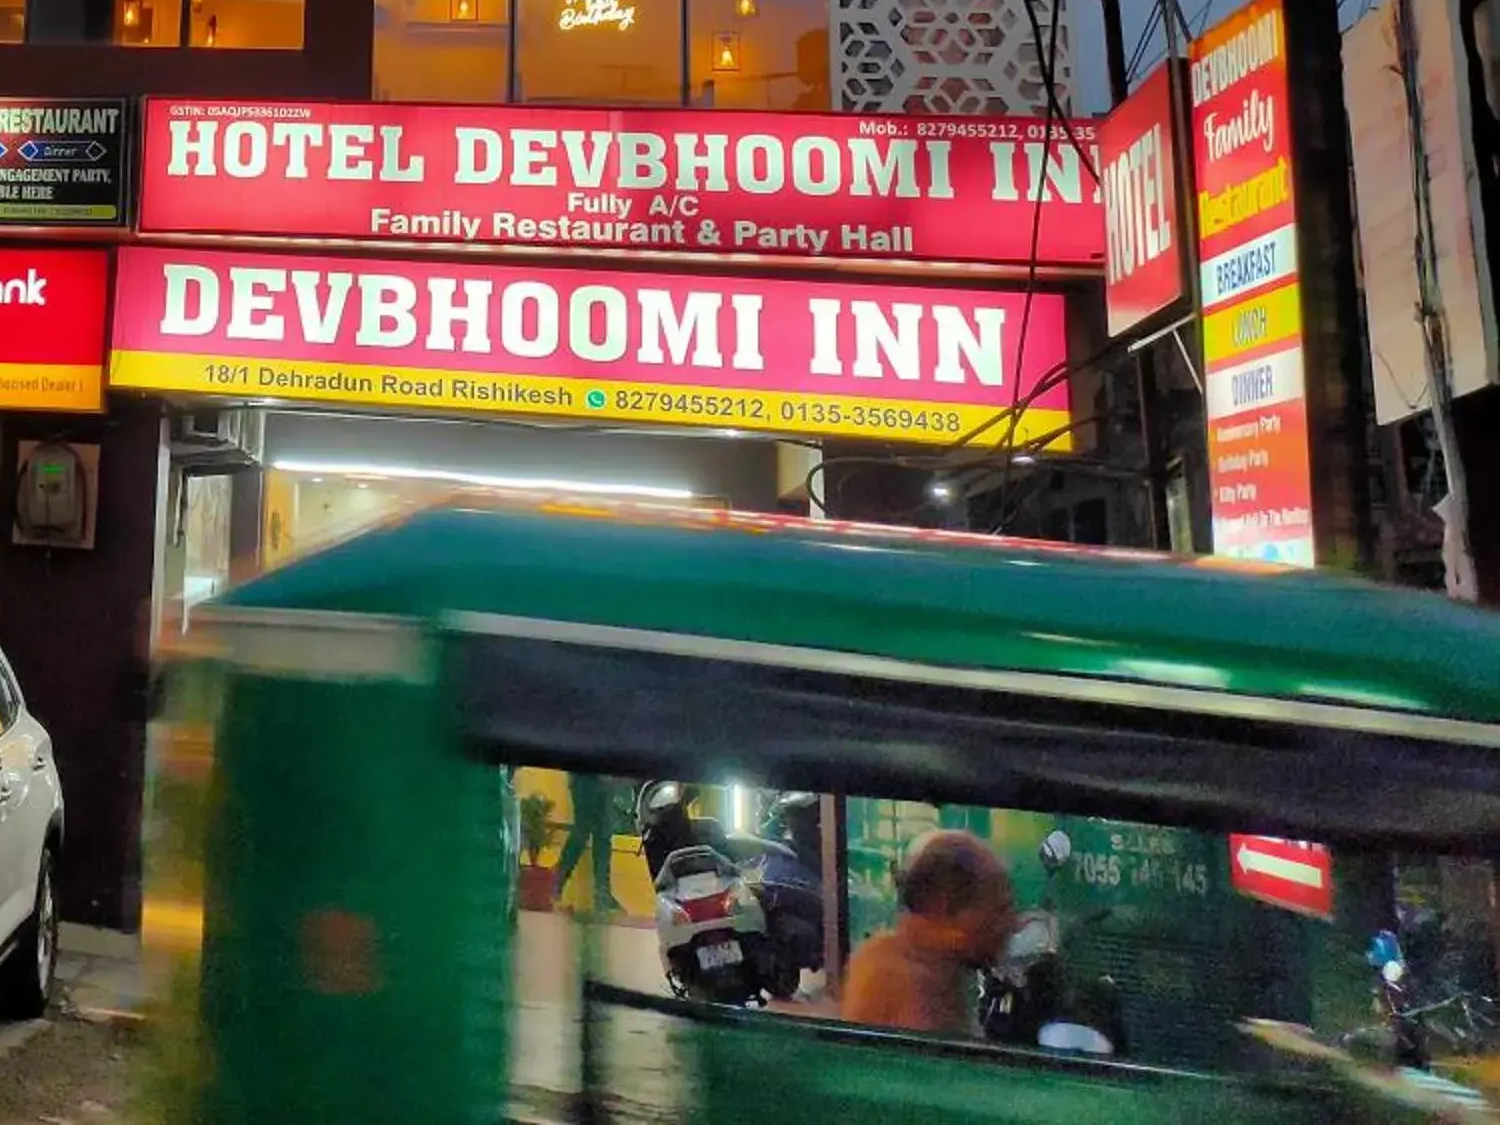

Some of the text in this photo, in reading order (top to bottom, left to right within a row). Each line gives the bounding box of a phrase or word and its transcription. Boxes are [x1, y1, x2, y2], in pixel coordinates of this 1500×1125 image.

[1191, 8, 1278, 107] DEVBHOOMI
[43, 145, 77, 157] Dinner
[916, 123, 1024, 140] 8279455212,
[1203, 88, 1275, 163] Family
[167, 121, 425, 182] HOTEL
[454, 126, 955, 199] DEVBHOOMI
[21, 186, 53, 200] HERE
[567, 192, 699, 218] Fully A/C
[1103, 123, 1172, 286] HOTEL
[370, 208, 914, 253] Family Restaurant & Party Hall
[1215, 241, 1276, 296] BREAKFAST
[159, 262, 1006, 386] DEVBHOOMI INN
[204, 364, 961, 433] 18/1 Dehradun Road Rishikesh 8279455212, 0135-3569438
[1231, 364, 1274, 407] DINNER
